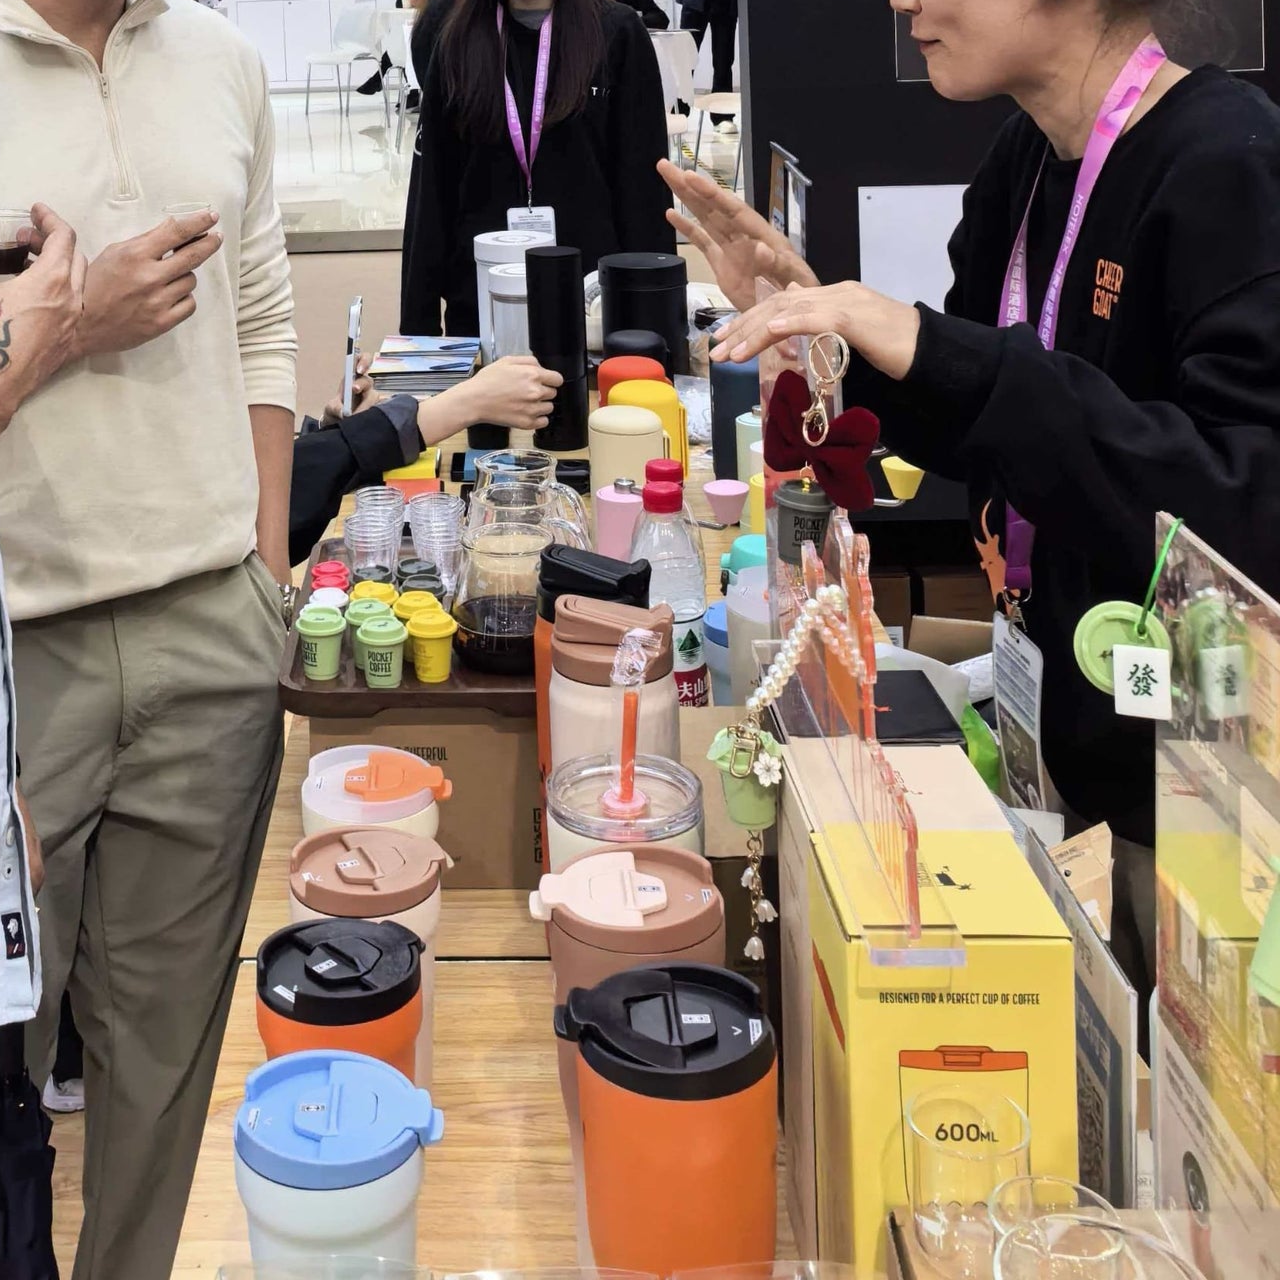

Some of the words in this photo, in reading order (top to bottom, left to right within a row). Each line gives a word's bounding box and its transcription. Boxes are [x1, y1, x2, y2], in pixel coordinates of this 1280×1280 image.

[1061, 193, 1085, 255] HOTELEX
[1095, 258, 1124, 294] CHEER
[367, 650, 394, 663] POCKET
[369, 662, 392, 673] COFFEE
[1127, 663, 1159, 697] 發
[879, 992, 920, 1004] DESIGNED
[921, 992, 936, 1004] FOR
[938, 992, 944, 1004] A
[946, 993, 980, 1005] PERFECT
[982, 993, 998, 1005] CUP
[1001, 993, 1010, 1005] OF
[1012, 993, 1040, 1005] COFFEE
[935, 1122, 999, 1143] 600ML
